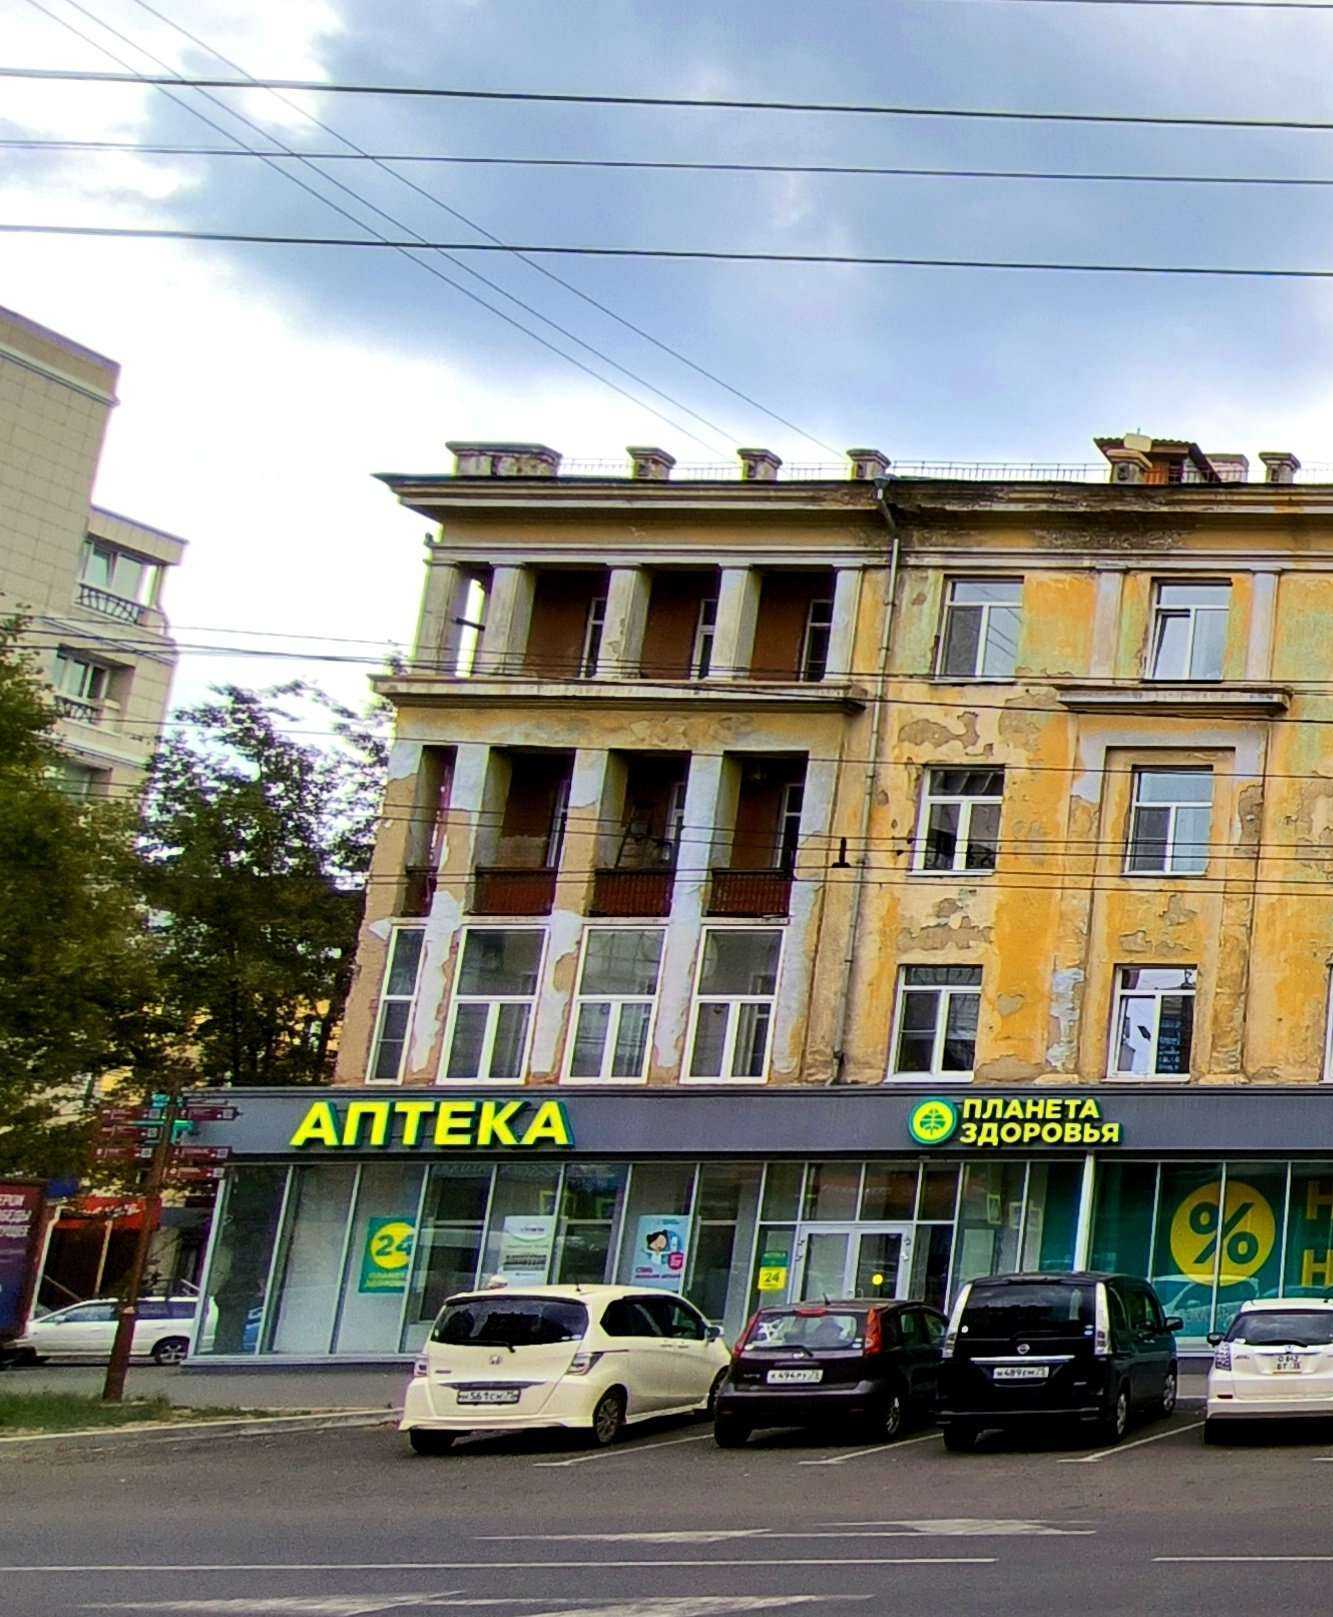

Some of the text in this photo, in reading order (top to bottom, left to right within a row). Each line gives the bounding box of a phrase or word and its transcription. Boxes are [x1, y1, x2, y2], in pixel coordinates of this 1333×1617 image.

[962, 1099, 1101, 1120] ПЛАНЕТА
[289, 1100, 572, 1147] АПТЕКА
[959, 1122, 1121, 1146] ЗДОРОВЬЯ
[374, 1233, 412, 1257] 24
[764, 1271, 780, 1283] 24
